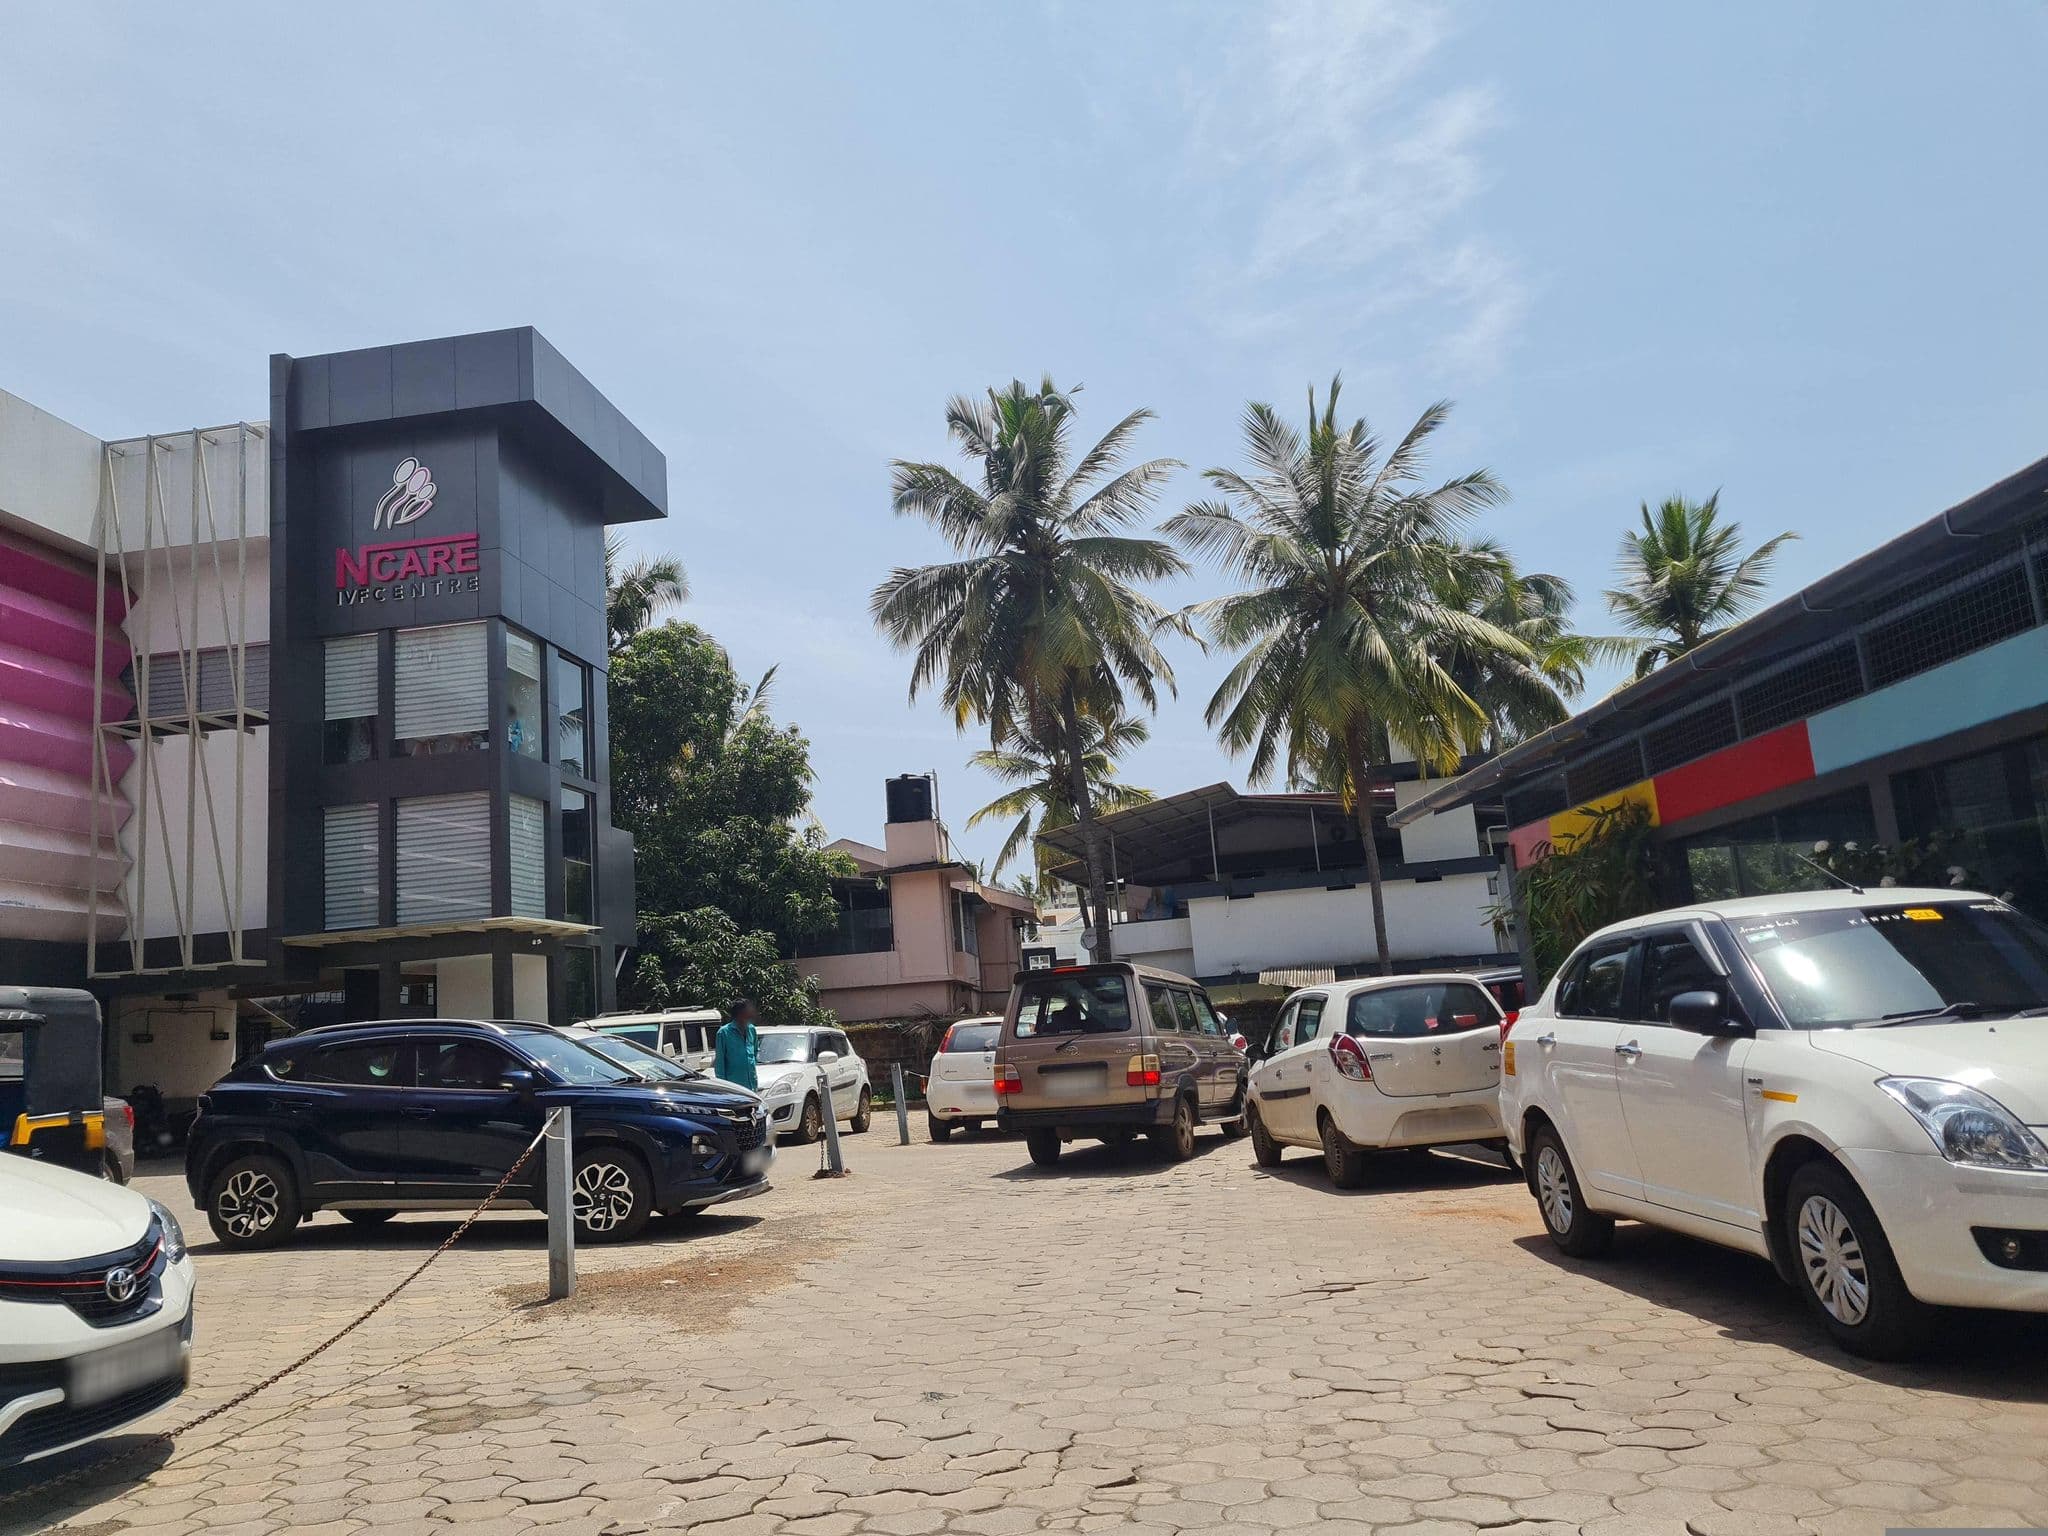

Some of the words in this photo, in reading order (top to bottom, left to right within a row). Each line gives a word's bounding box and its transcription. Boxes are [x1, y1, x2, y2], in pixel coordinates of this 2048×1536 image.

[336, 533, 480, 589] NCARE
[337, 589, 369, 606] IVF
[374, 576, 480, 602] CENTRE
